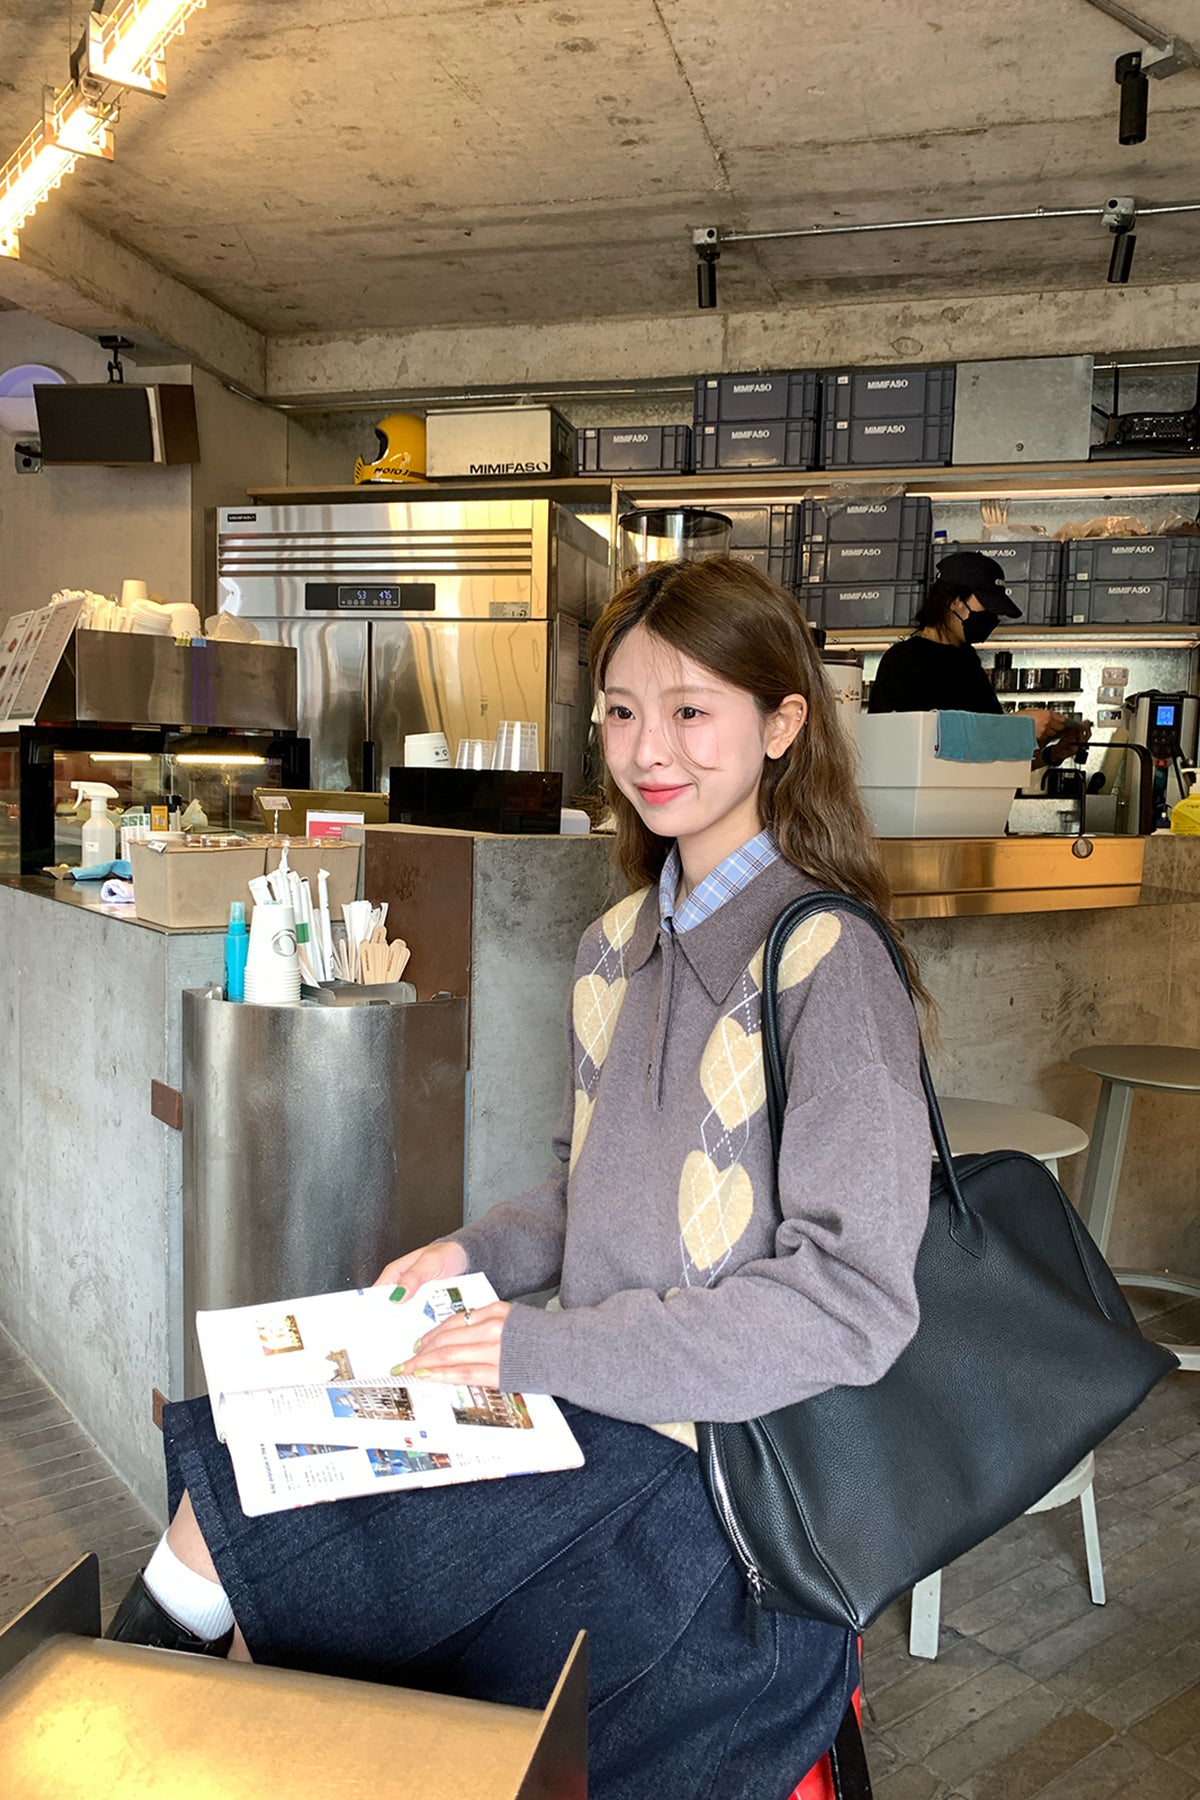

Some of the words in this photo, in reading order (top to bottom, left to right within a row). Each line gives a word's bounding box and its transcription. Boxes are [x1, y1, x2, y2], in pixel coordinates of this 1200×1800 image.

[733, 383, 772, 393] MIMIFASO
[867, 379, 908, 389] MIMIFASO
[864, 425, 906, 434] MIMIFASO
[613, 434, 648, 443] MIMIFASO
[731, 430, 770, 439] MIMIFASO
[374, 467, 402, 475] MOTO
[469, 461, 549, 474] MIMIFASO
[847, 505, 887, 514] MIMIFASO
[841, 548, 882, 557] MIMIFASO
[1112, 545, 1154, 554] MIMIFASO
[1108, 586, 1151, 594] MIMIFASO
[839, 591, 880, 601] MIMIFASO
